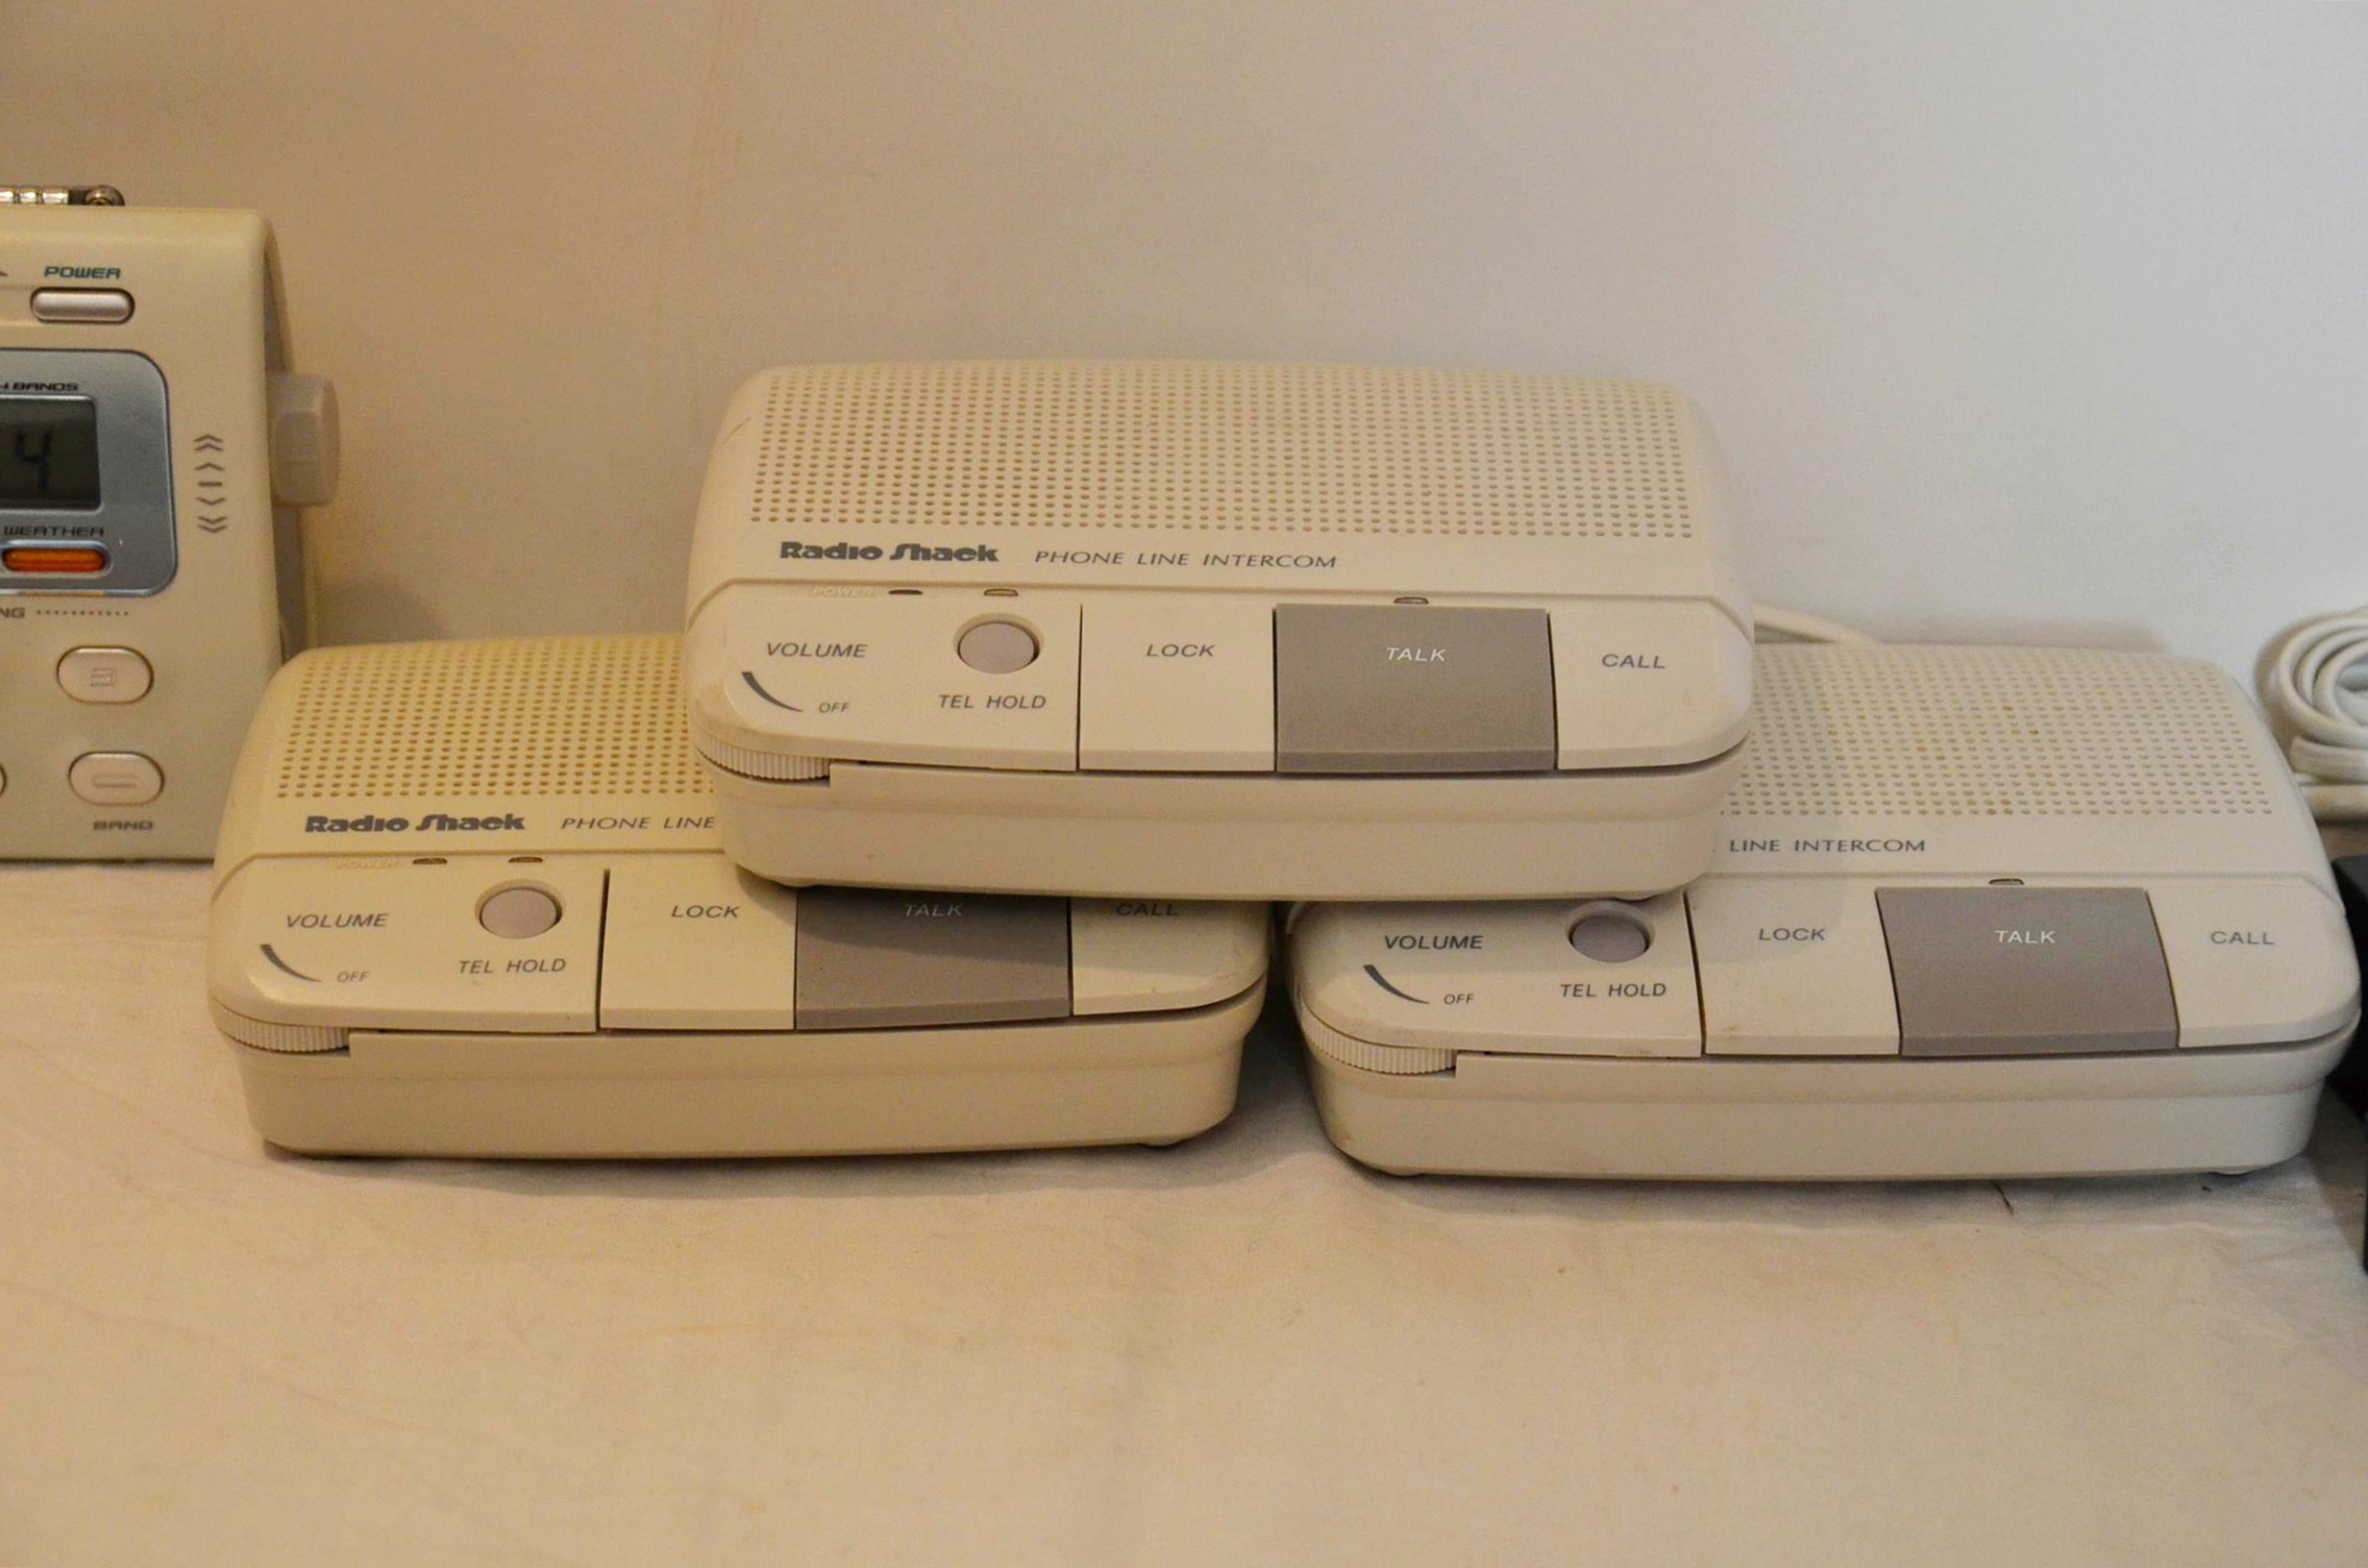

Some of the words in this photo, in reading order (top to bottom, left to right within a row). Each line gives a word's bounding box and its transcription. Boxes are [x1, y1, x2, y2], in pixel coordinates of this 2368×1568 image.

[44, 266, 121, 279] POWER
[4, 525, 105, 537] WEATHER
[779, 541, 883, 560] Radio
[889, 543, 999, 562] Shack
[1034, 551, 1124, 565] PHONE
[1137, 552, 1190, 566] LINE
[1202, 553, 1337, 568] INTERCOM
[766, 643, 868, 658] VOLUME
[1146, 644, 1216, 657] LOCK
[1386, 648, 1446, 662] TALK
[1601, 653, 1666, 669] CALL
[818, 702, 850, 714] OFF
[938, 695, 974, 709] TEL
[986, 695, 1047, 709] HOLD
[93, 820, 154, 831] BAND
[305, 816, 409, 832] Radio
[415, 814, 526, 831] Shack
[560, 816, 652, 830] PHONE
[663, 817, 715, 829] LINE
[1730, 839, 1781, 852] LINE
[1793, 839, 1926, 852] INTERCOM
[671, 905, 740, 919] LOCK
[904, 904, 963, 918] TALK
[1115, 903, 1180, 917] CALL
[286, 913, 388, 929] VOLUME
[1384, 935, 1485, 949] VOLUME
[1759, 928, 1826, 942] LOCK
[1995, 930, 2056, 944] TALK
[2210, 931, 2276, 945] CALL
[458, 960, 494, 974] TEL
[506, 959, 567, 973] HOLD
[336, 971, 370, 983] OFF
[1560, 983, 1596, 997] TEL
[1608, 983, 1667, 997] HOLD
[1443, 993, 1474, 1005] OFF
